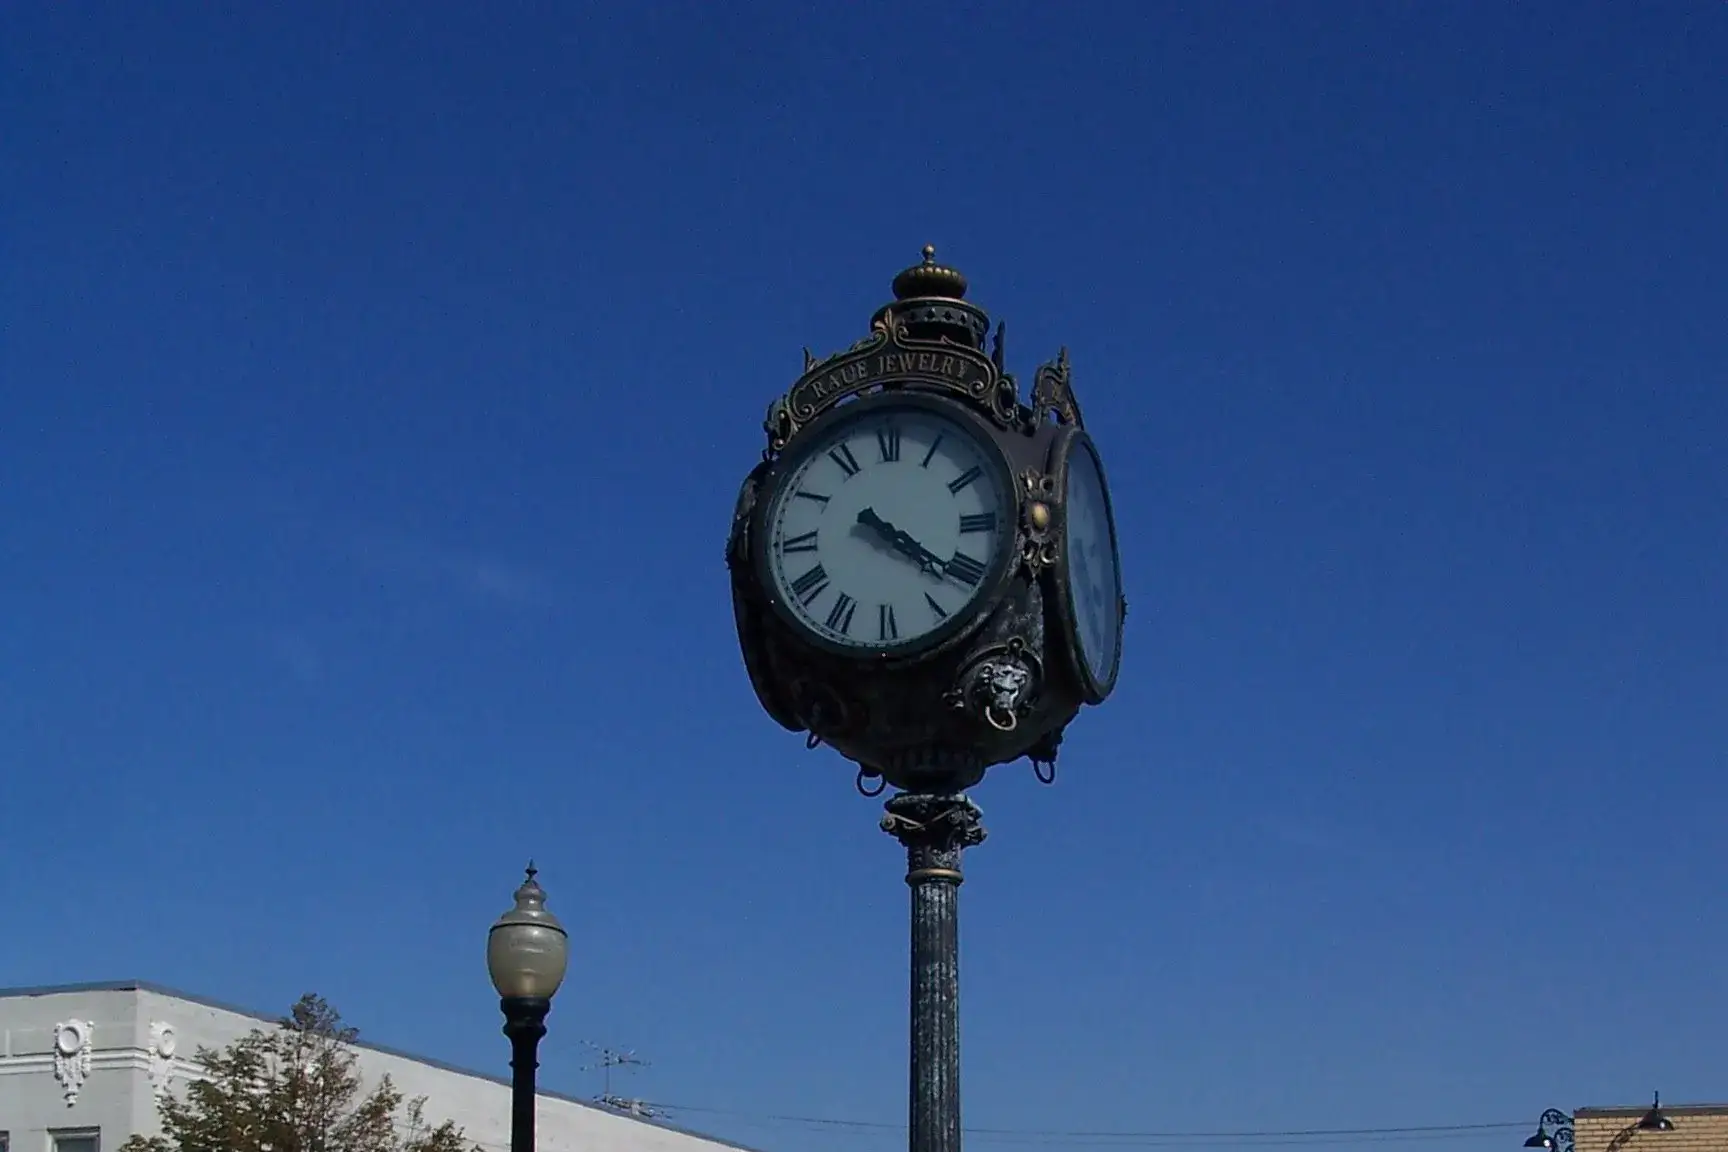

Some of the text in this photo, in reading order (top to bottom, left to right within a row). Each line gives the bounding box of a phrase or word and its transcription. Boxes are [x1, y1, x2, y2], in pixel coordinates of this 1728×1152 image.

[811, 353, 971, 398] RAUE JEWELRY
[960, 510, 996, 537] III
